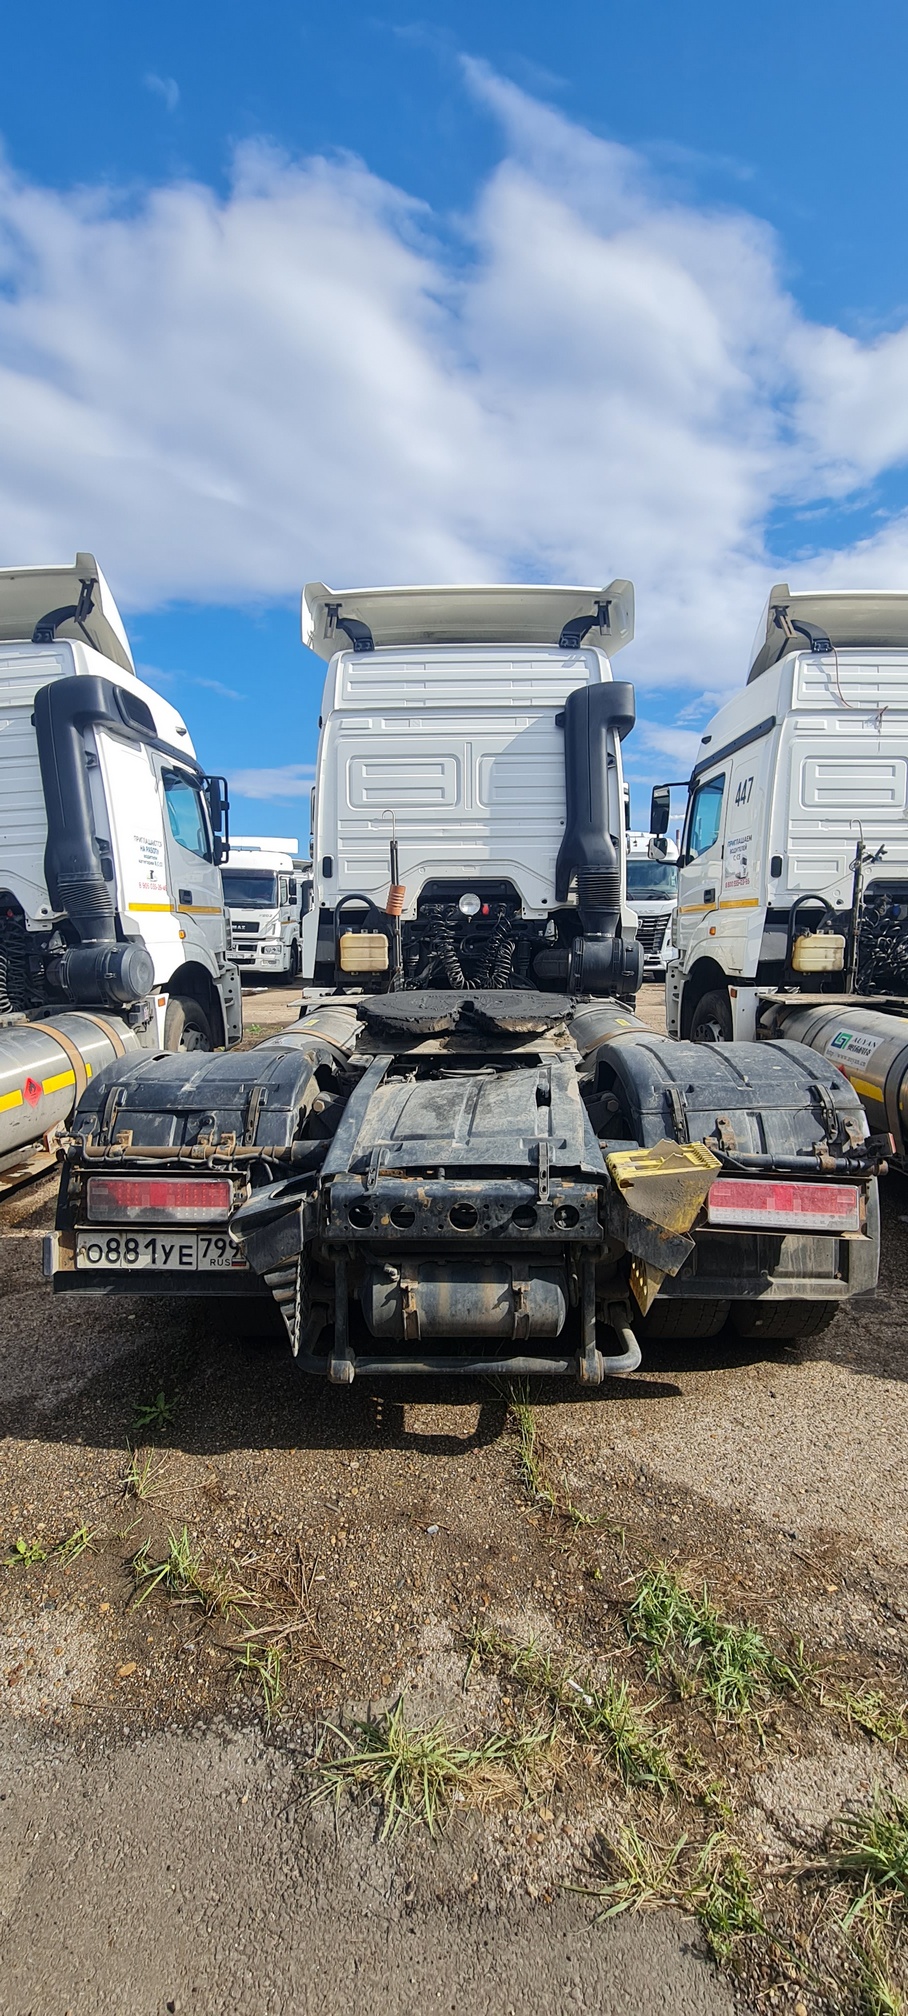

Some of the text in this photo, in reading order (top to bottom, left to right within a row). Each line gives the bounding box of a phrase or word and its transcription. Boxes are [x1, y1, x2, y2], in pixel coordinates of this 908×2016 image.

[735, 776, 754, 807] 447
[853, 1037, 877, 1048] AUYAN
[200, 1237, 241, 1259] 799
[210, 1258, 231, 1267] RUS
